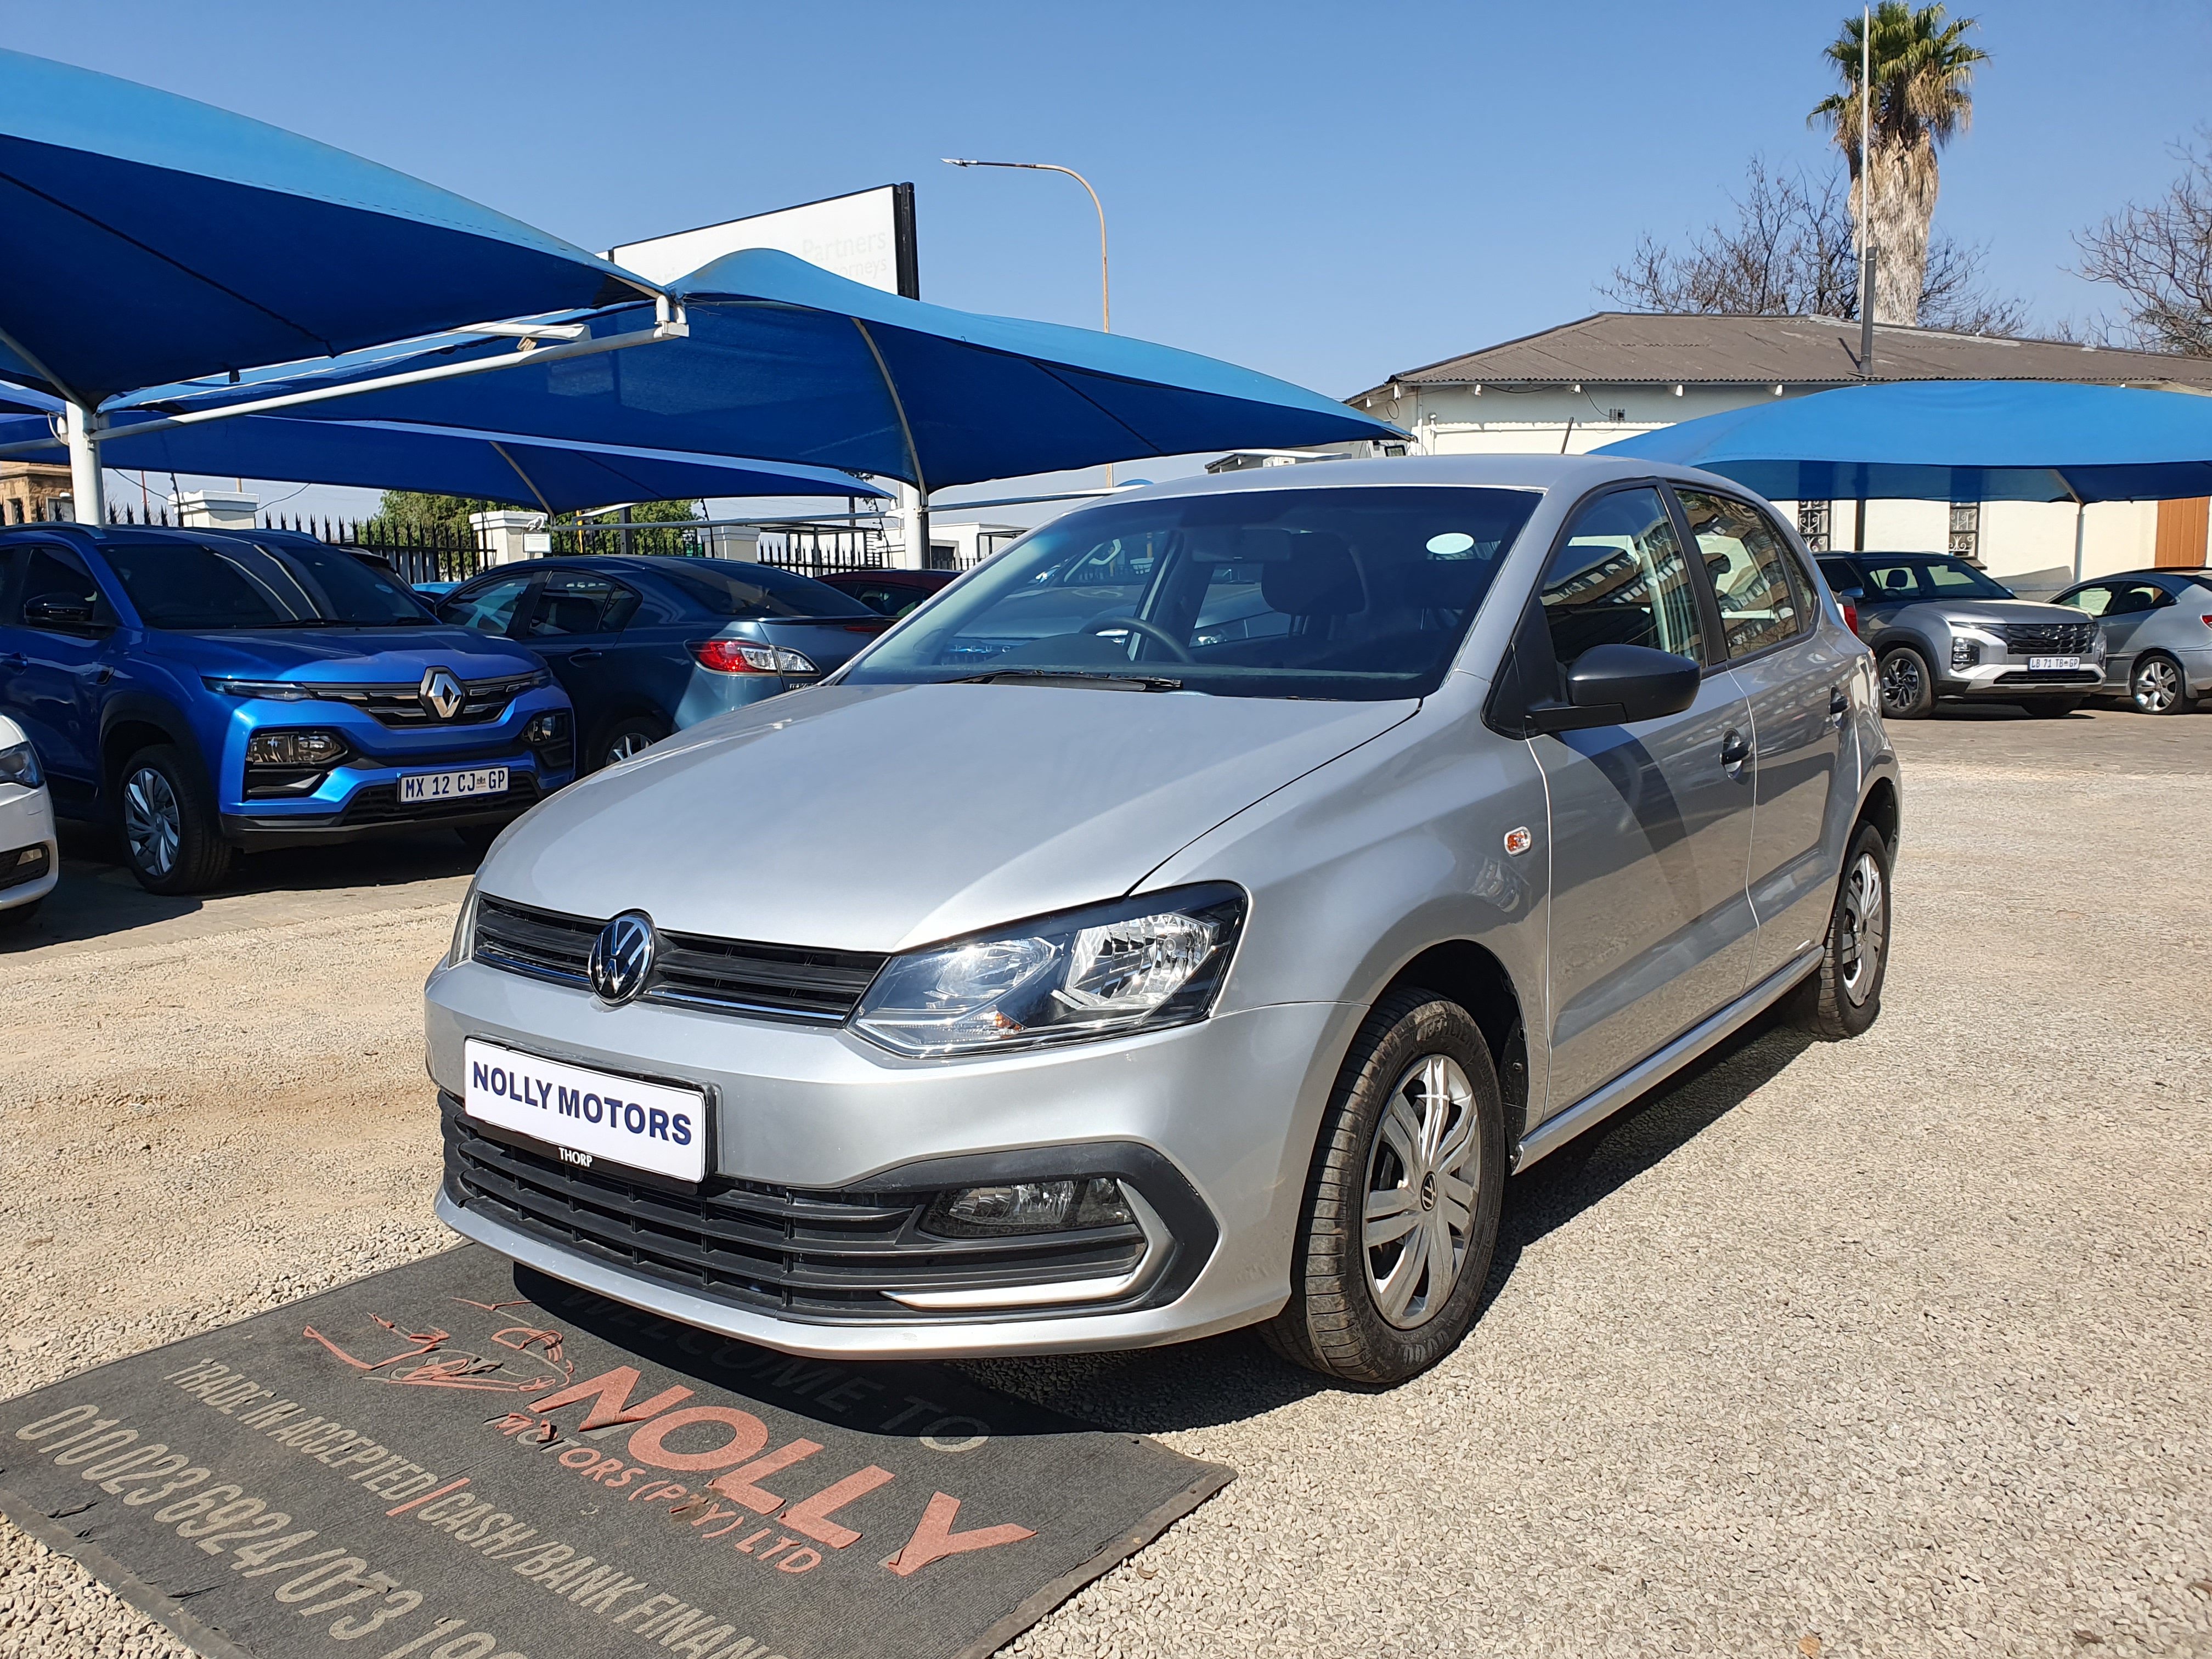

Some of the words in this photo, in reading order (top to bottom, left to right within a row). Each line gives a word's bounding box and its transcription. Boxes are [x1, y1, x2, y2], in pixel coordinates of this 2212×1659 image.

[803, 232, 887, 261] Partners
[2032, 659, 2040, 668] LB
[2044, 659, 2052, 668] 71
[2069, 659, 2078, 667] GP
[406, 778, 425, 798] MX
[432, 776, 450, 795] 12
[458, 773, 476, 792] CJ
[489, 770, 505, 789] GP
[473, 1061, 552, 1110] NOLLY
[558, 1086, 692, 1146] MOTORS
[558, 1147, 592, 1168] THORP
[879, 1395, 989, 1453] TO
[527, 1365, 1037, 1576] NOLLY
[163, 1357, 276, 1415] TRADE
[237, 1398, 307, 1430] IN
[613, 1592, 791, 1659] FINAN
